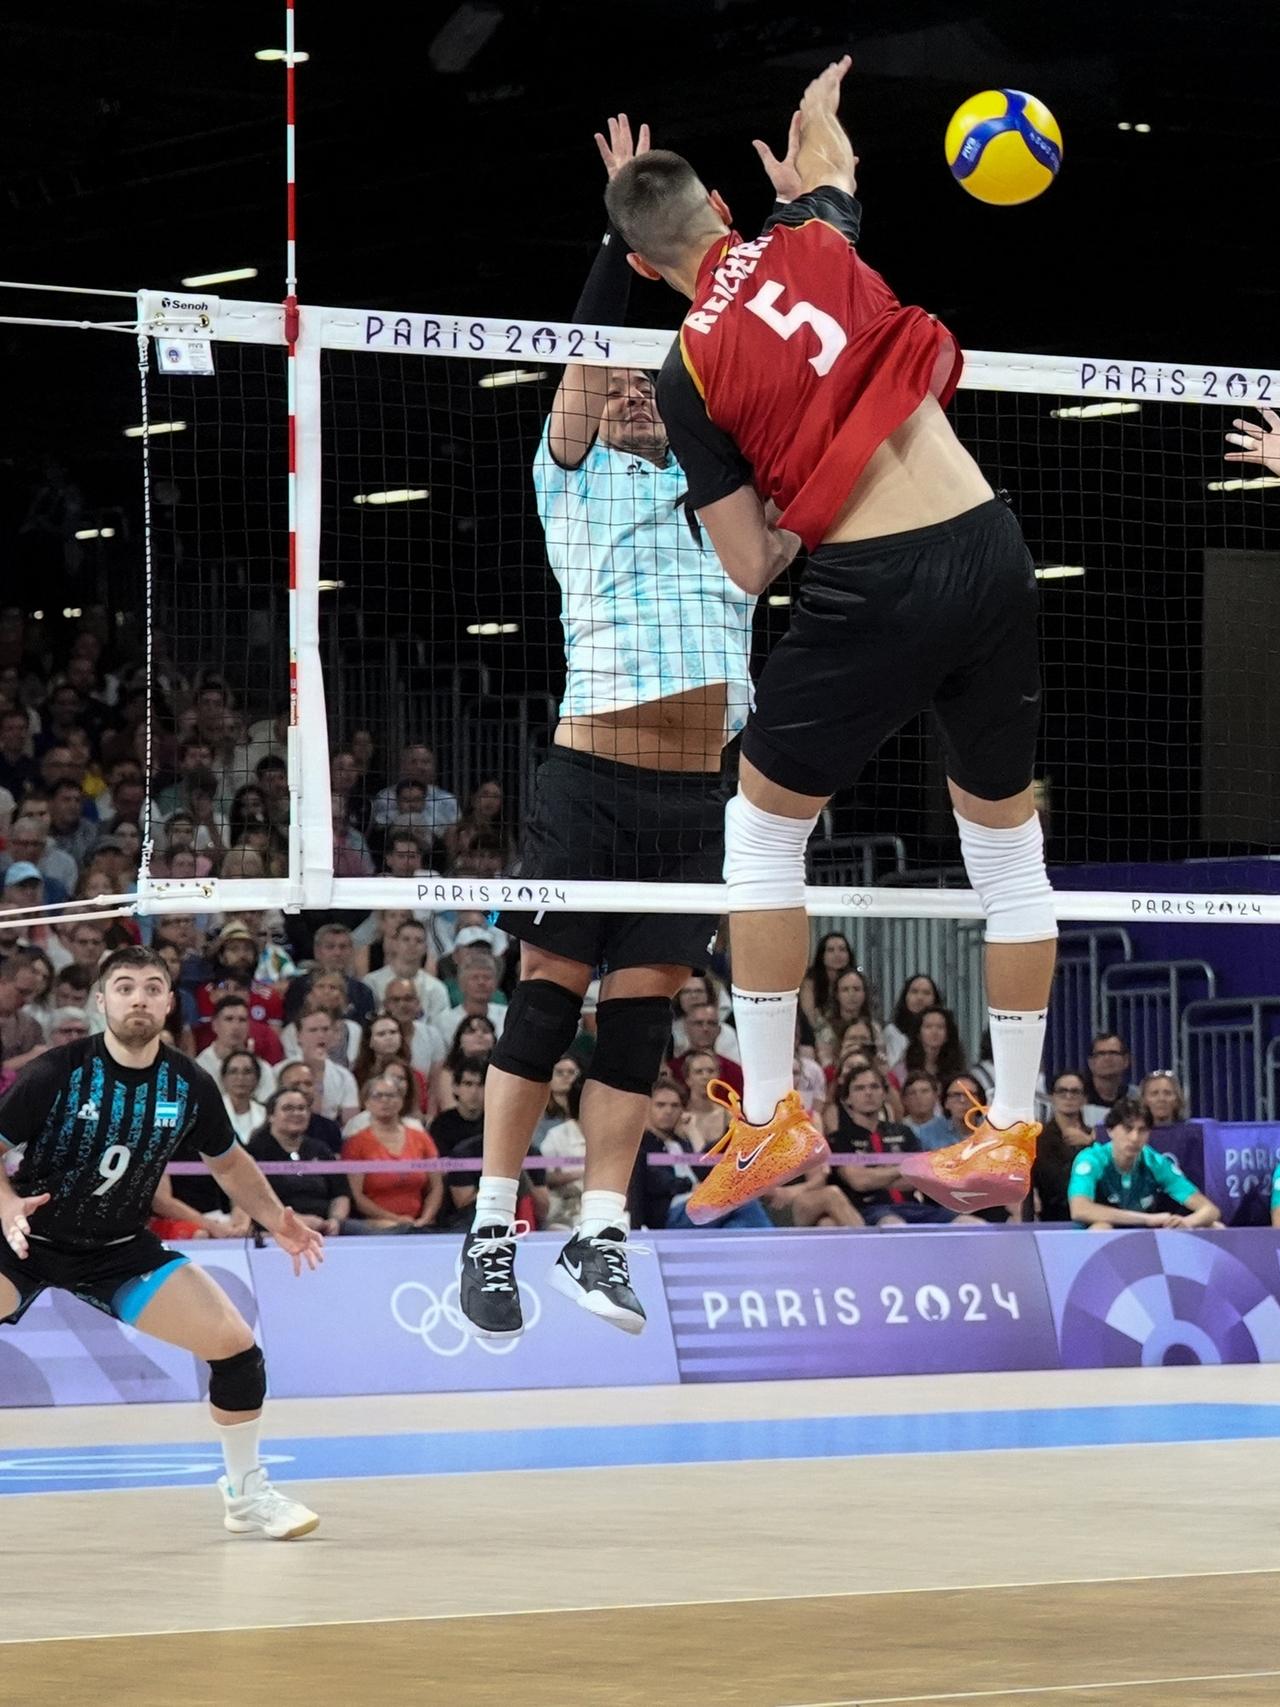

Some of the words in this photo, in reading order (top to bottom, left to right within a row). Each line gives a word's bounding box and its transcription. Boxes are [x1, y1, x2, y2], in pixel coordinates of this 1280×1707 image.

[172, 300, 208, 311] Senoh
[505, 325, 610, 358] 2024
[744, 280, 847, 377] 5
[501, 886, 566, 903] 2024
[1205, 901, 1261, 916] 2024
[92, 1145, 131, 1196] 9
[1226, 1174, 1271, 1197] 202
[880, 1283, 1020, 1324] 2024
